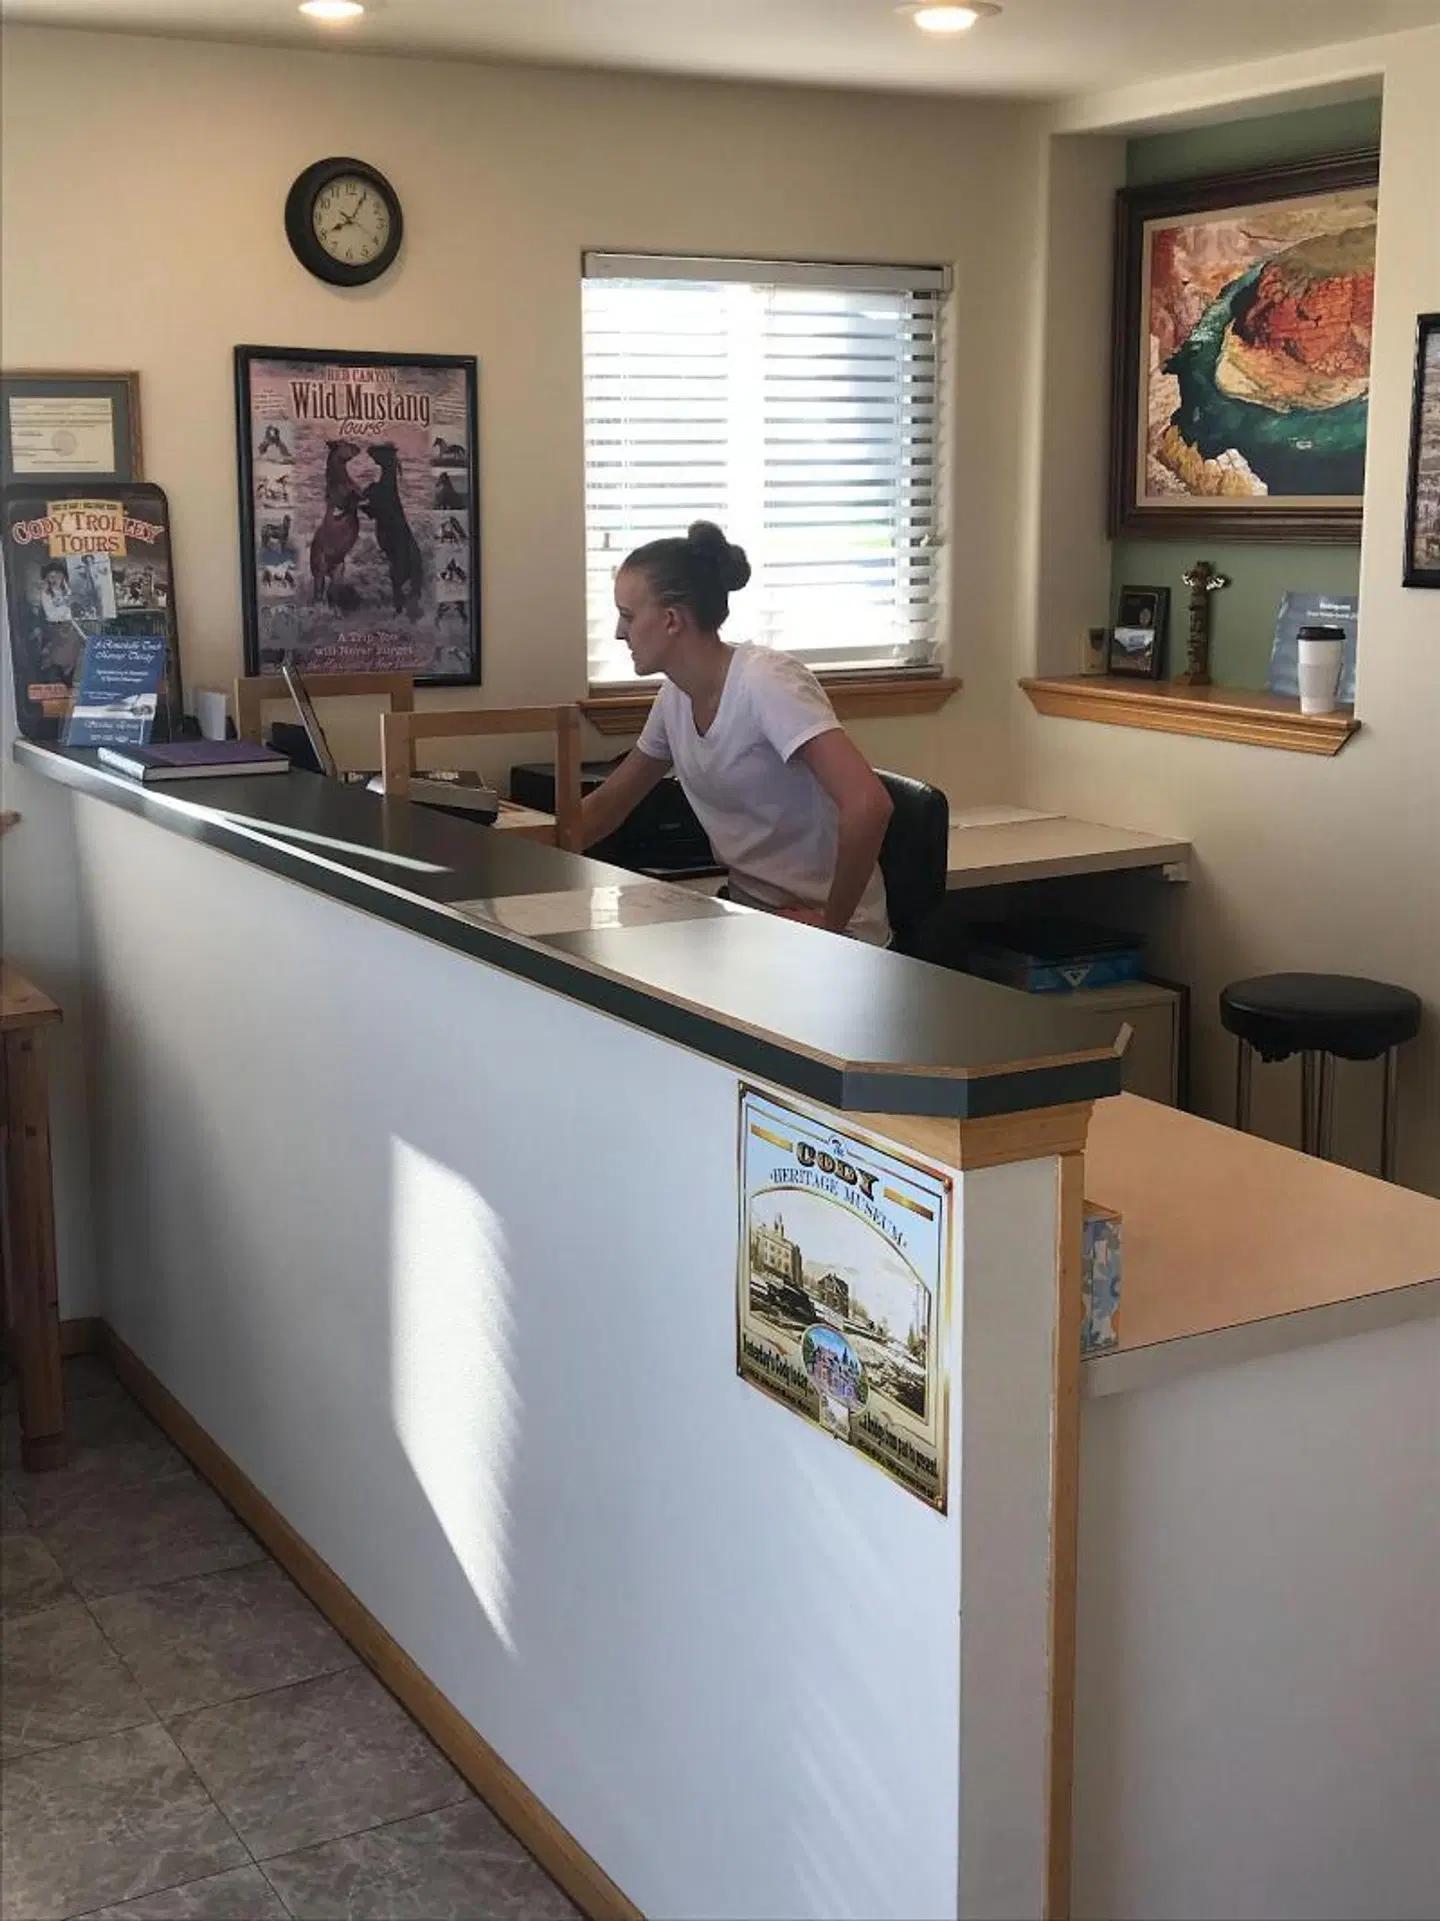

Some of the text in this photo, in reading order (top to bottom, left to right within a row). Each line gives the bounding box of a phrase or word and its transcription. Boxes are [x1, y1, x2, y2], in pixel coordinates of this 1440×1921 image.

[290, 383, 337, 420] Wild
[346, 384, 430, 427] Mustang
[339, 420, 385, 435] Tours
[796, 1141, 880, 1201] CODY
[773, 1168, 904, 1247] HERITAGE MUSEUM
